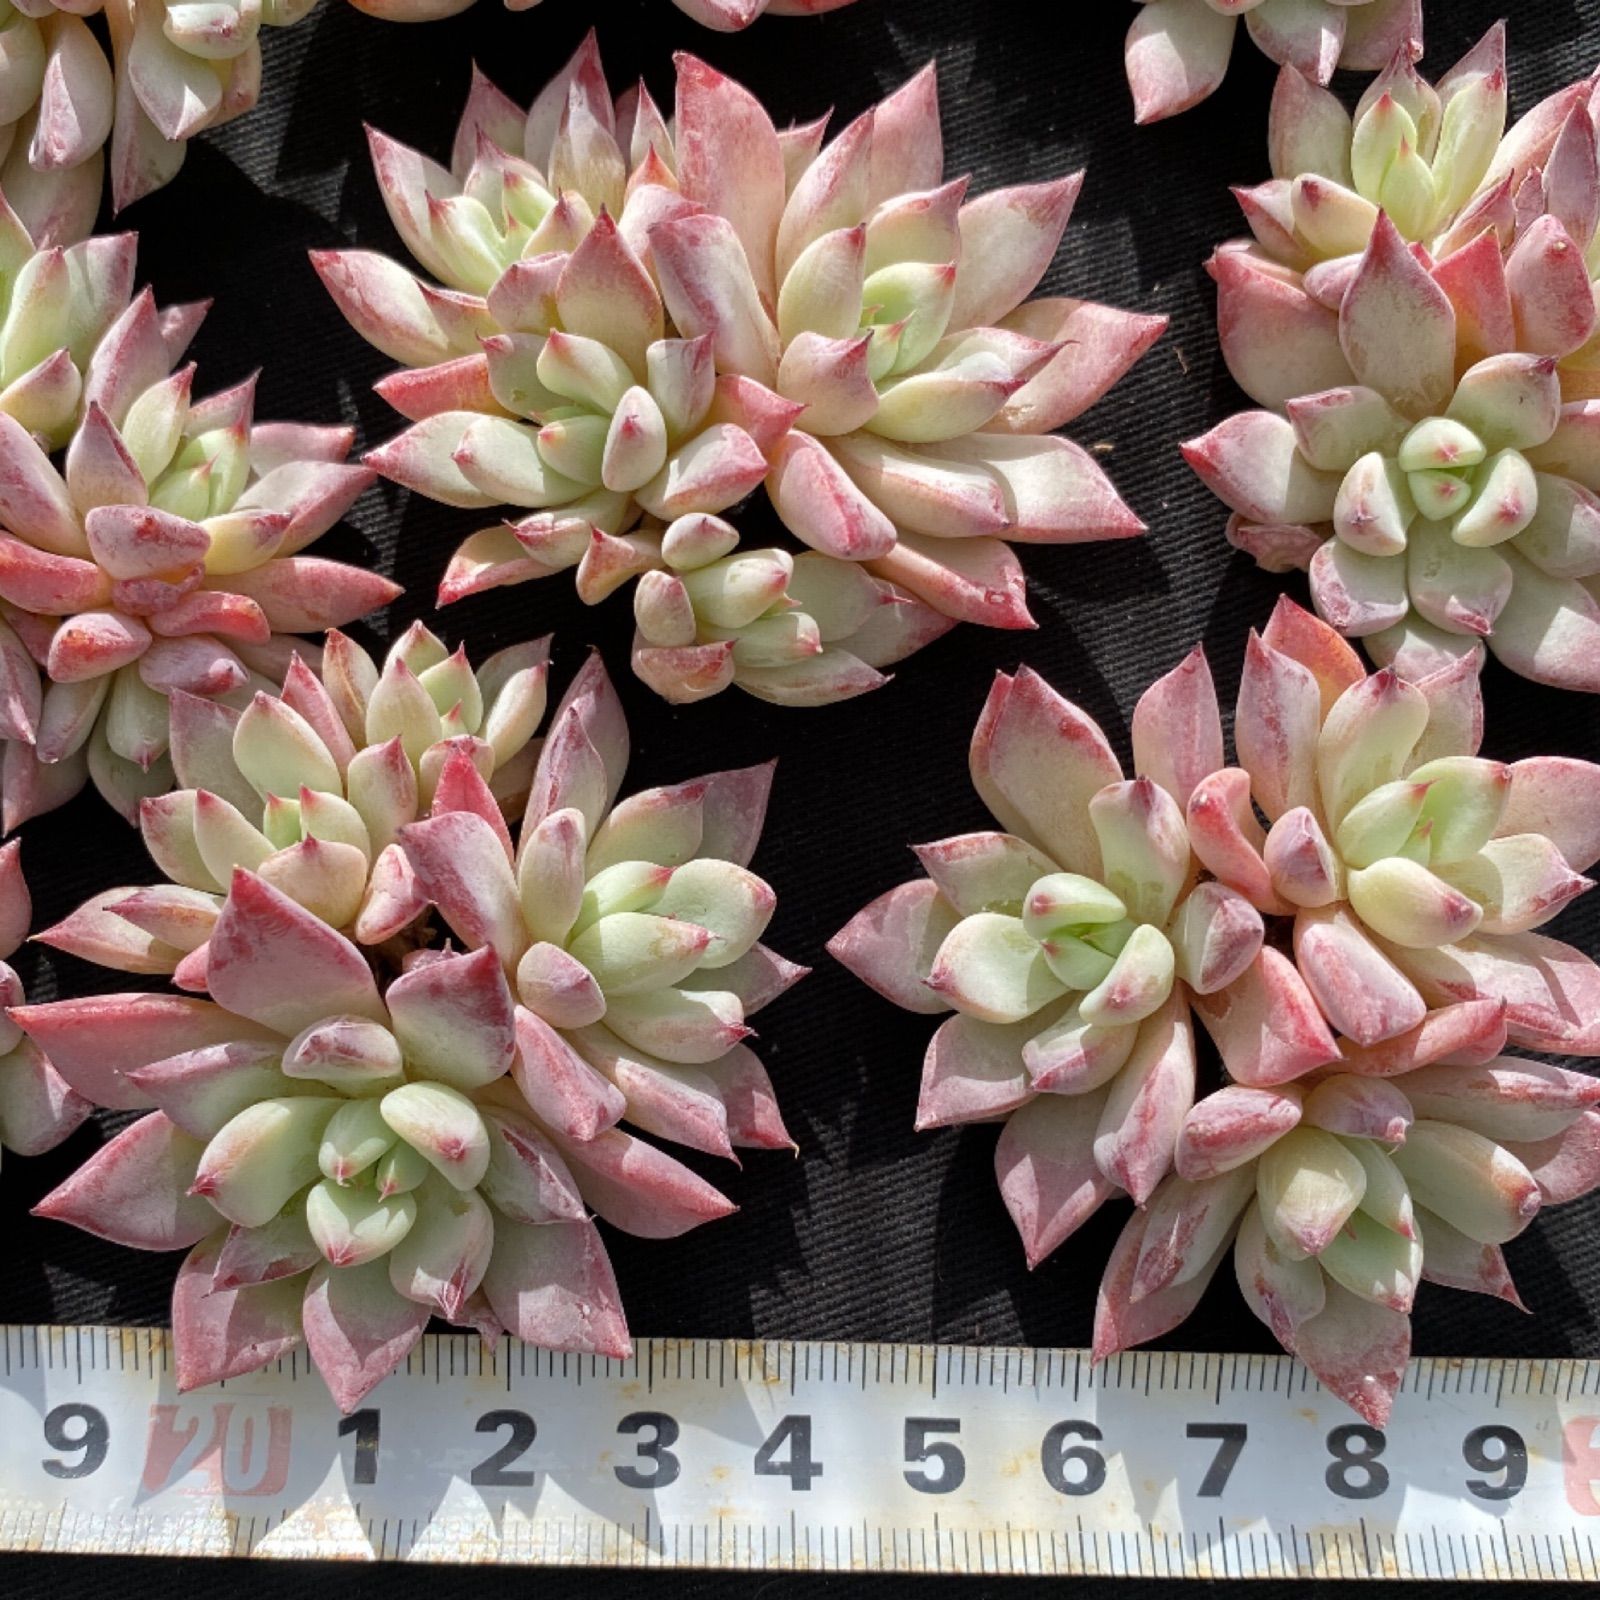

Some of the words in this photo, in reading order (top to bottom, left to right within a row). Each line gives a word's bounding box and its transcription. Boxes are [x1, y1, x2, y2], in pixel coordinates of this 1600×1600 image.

[42, 1403, 110, 1479] 9
[158, 1403, 276, 1494] 20
[338, 1408, 381, 1485] 1
[470, 1408, 537, 1487] 2
[613, 1411, 681, 1489] 3
[754, 1414, 823, 1491] 4
[903, 1417, 966, 1494] 5
[1041, 1419, 1107, 1496] 6
[1186, 1423, 1248, 1498] 7
[1325, 1423, 1390, 1500] 8
[1462, 1424, 1528, 1500] 9
